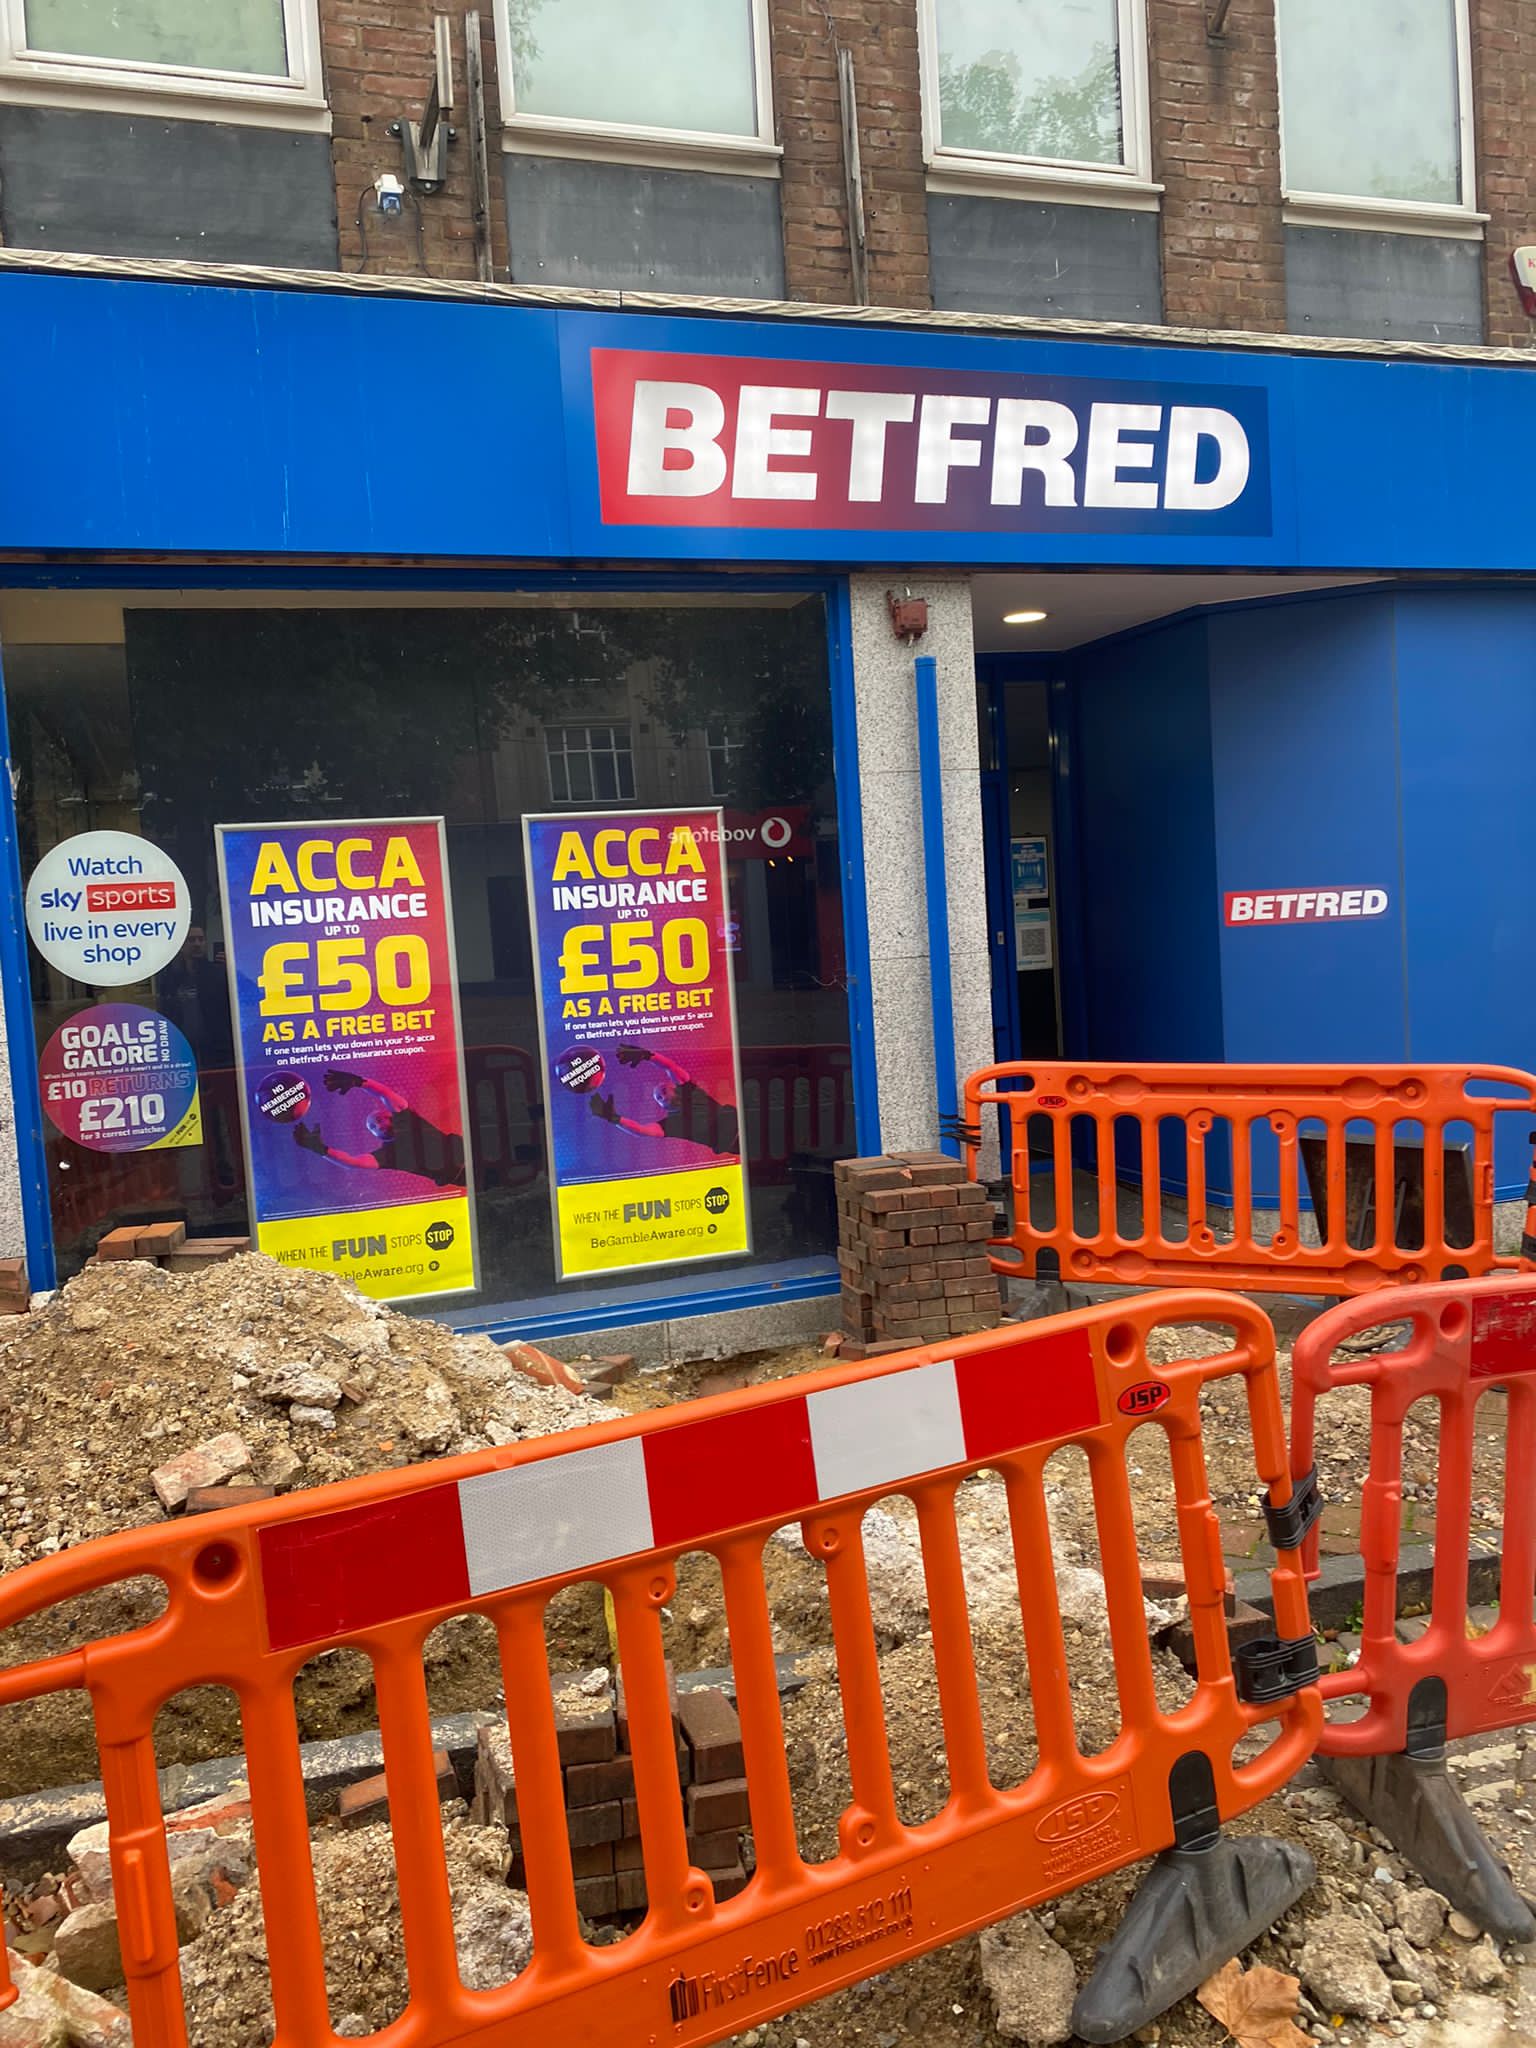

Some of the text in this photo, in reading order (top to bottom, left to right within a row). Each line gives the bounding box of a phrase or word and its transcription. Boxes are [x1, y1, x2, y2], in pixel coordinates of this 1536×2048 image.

[626, 379, 1250, 511] BETFRED
[68, 855, 143, 876] Watch
[250, 836, 426, 895] ACCA
[552, 825, 706, 881] ACCA
[40, 886, 171, 912] sky sports
[553, 878, 708, 911] INSURANCE
[1230, 889, 1389, 922] BETFRED
[250, 893, 428, 928] INSURANCE
[617, 908, 649, 920] UP TO
[44, 920, 176, 941] live in every
[324, 924, 360, 936] UP TO
[83, 944, 141, 966] shop
[558, 917, 711, 994] £50
[258, 934, 432, 1017] £50
[562, 988, 714, 1019] AS A FREE BET
[61, 1020, 157, 1050] GOALS
[262, 1009, 435, 1043] AS A FREE BET
[564, 1022, 571, 1031] If
[588, 1021, 608, 1029] team
[608, 1019, 624, 1027] lets
[625, 1019, 639, 1028] you
[640, 1016, 661, 1025] down
[670, 1014, 686, 1023] your
[586, 1029, 622, 1039] Betfred's
[623, 1028, 641, 1036] Acca
[641, 1025, 677, 1034] Insurance
[158, 1020, 170, 1062] NO DRAW
[265, 1046, 272, 1056] If
[273, 1047, 290, 1055] one
[291, 1045, 314, 1053] team
[314, 1043, 332, 1051] lets
[332, 1042, 349, 1052] you
[350, 1039, 374, 1048] down
[384, 1037, 403, 1047] your
[416, 1034, 435, 1042] acca
[63, 1044, 159, 1070] GALORE
[276, 1058, 289, 1066] on
[289, 1053, 329, 1065] Betfred's
[331, 1052, 351, 1061] Acca
[352, 1049, 393, 1059] Insurance
[560, 1054, 601, 1084] MEMBERSHIP
[570, 1056, 583, 1067] NO
[48, 1069, 192, 1101] £10 RETURNS
[272, 1083, 285, 1095] NO
[569, 1064, 601, 1088] REQUIRED
[79, 1093, 165, 1131] £210
[260, 1081, 305, 1113] MEMBERSHIP
[270, 1092, 306, 1117] REQUIRED
[80, 1126, 167, 1141] for 3 correct matches
[573, 1193, 729, 1225] WHEN THE FUN STOPS STOP
[275, 1228, 454, 1262] WHEN THE FUN STOPS STOP
[590, 1225, 704, 1249] BeGambleAware.org
[1126, 1385, 1163, 1410] JSP
[1049, 1795, 1104, 1838] JSP
[888, 1886, 913, 1916] 111
